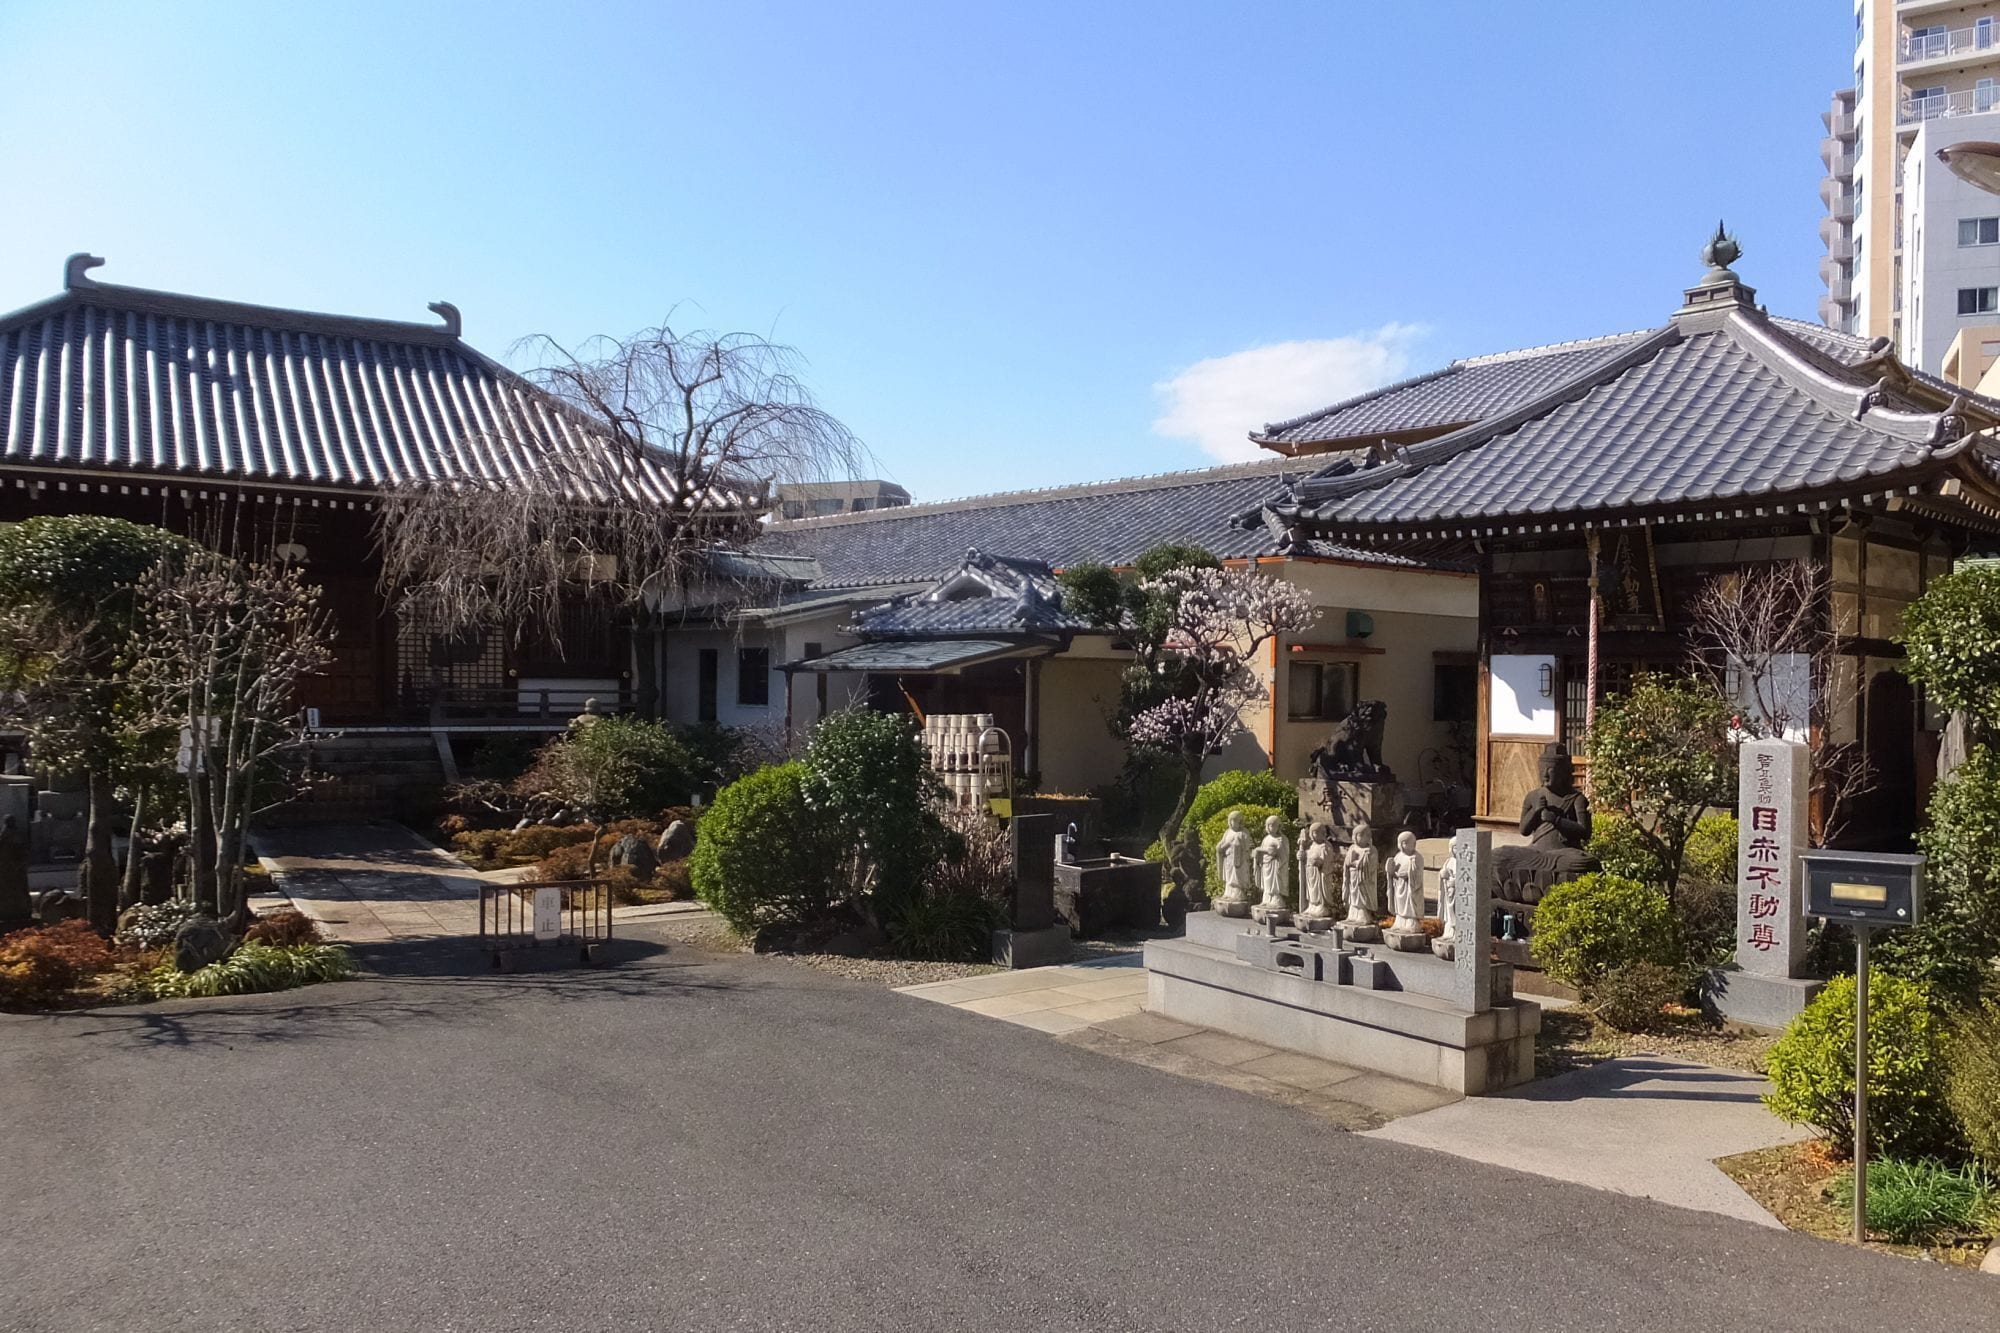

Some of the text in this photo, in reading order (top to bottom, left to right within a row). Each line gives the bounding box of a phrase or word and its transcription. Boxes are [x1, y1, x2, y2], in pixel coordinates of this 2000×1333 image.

[1746, 806, 1782, 952] 目赤不動尊
